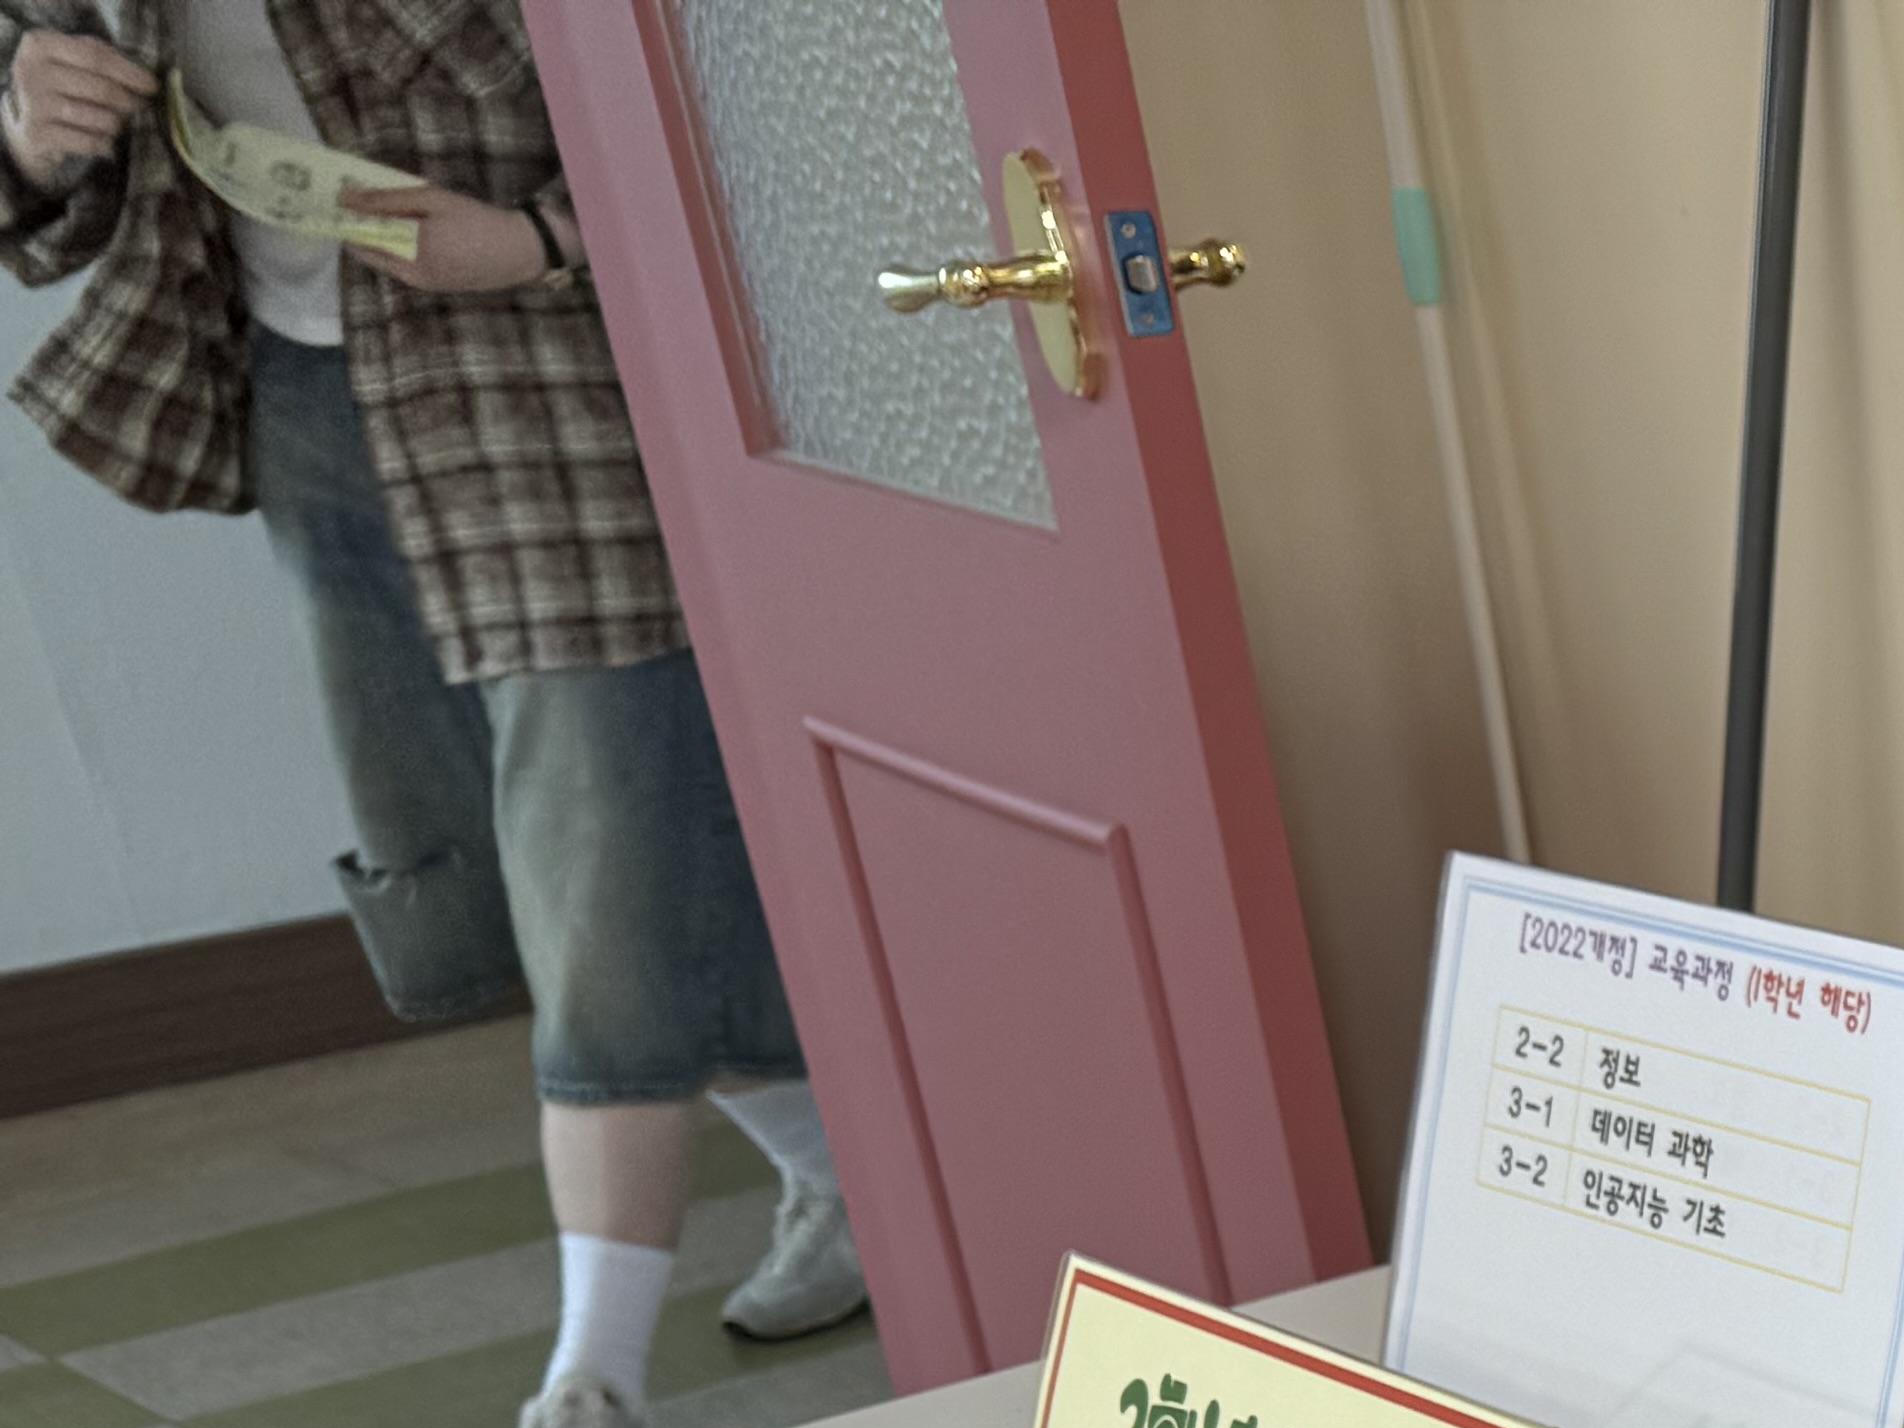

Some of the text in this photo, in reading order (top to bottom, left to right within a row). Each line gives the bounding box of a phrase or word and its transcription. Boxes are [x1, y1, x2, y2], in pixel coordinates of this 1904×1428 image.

[1518, 912, 1638, 980] [2022개정]
[1649, 942, 1735, 1002] 교육과정
[1820, 981, 1873, 1034] 해당)
[1515, 1026, 1642, 1088] 2-2 정보
[1507, 1087, 1715, 1179] 3-1 데이터 과학
[1498, 1145, 1727, 1240] 3-2 인공지능 기초
